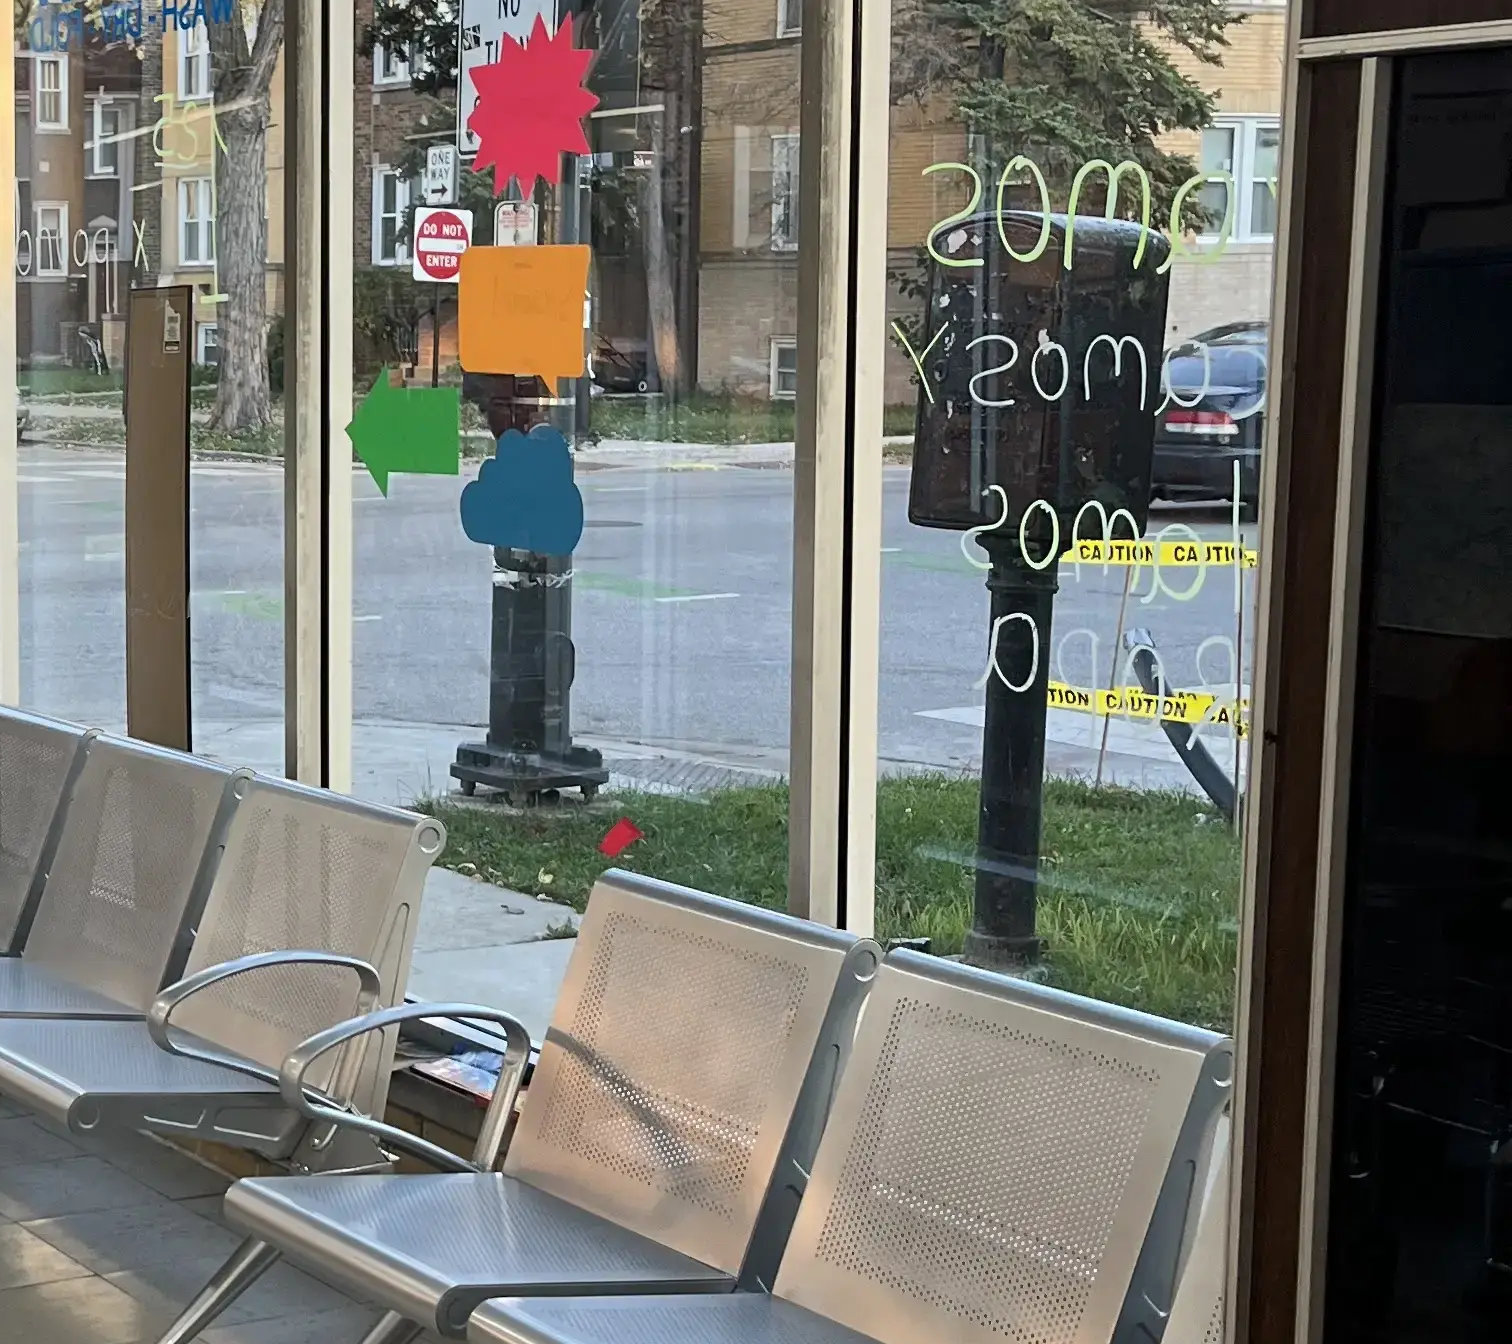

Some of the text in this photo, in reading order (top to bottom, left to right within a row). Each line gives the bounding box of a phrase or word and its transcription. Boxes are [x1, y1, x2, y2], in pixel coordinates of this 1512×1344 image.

[431, 151, 451, 166] ONE
[430, 166, 451, 181] WAY
[423, 222, 463, 237] DO NOT
[425, 254, 458, 268] ENTER
[1079, 544, 1244, 562] CAUTION CAUTIO
[1048, 688, 1090, 707] TION
[1105, 693, 1187, 718] CAUTION
